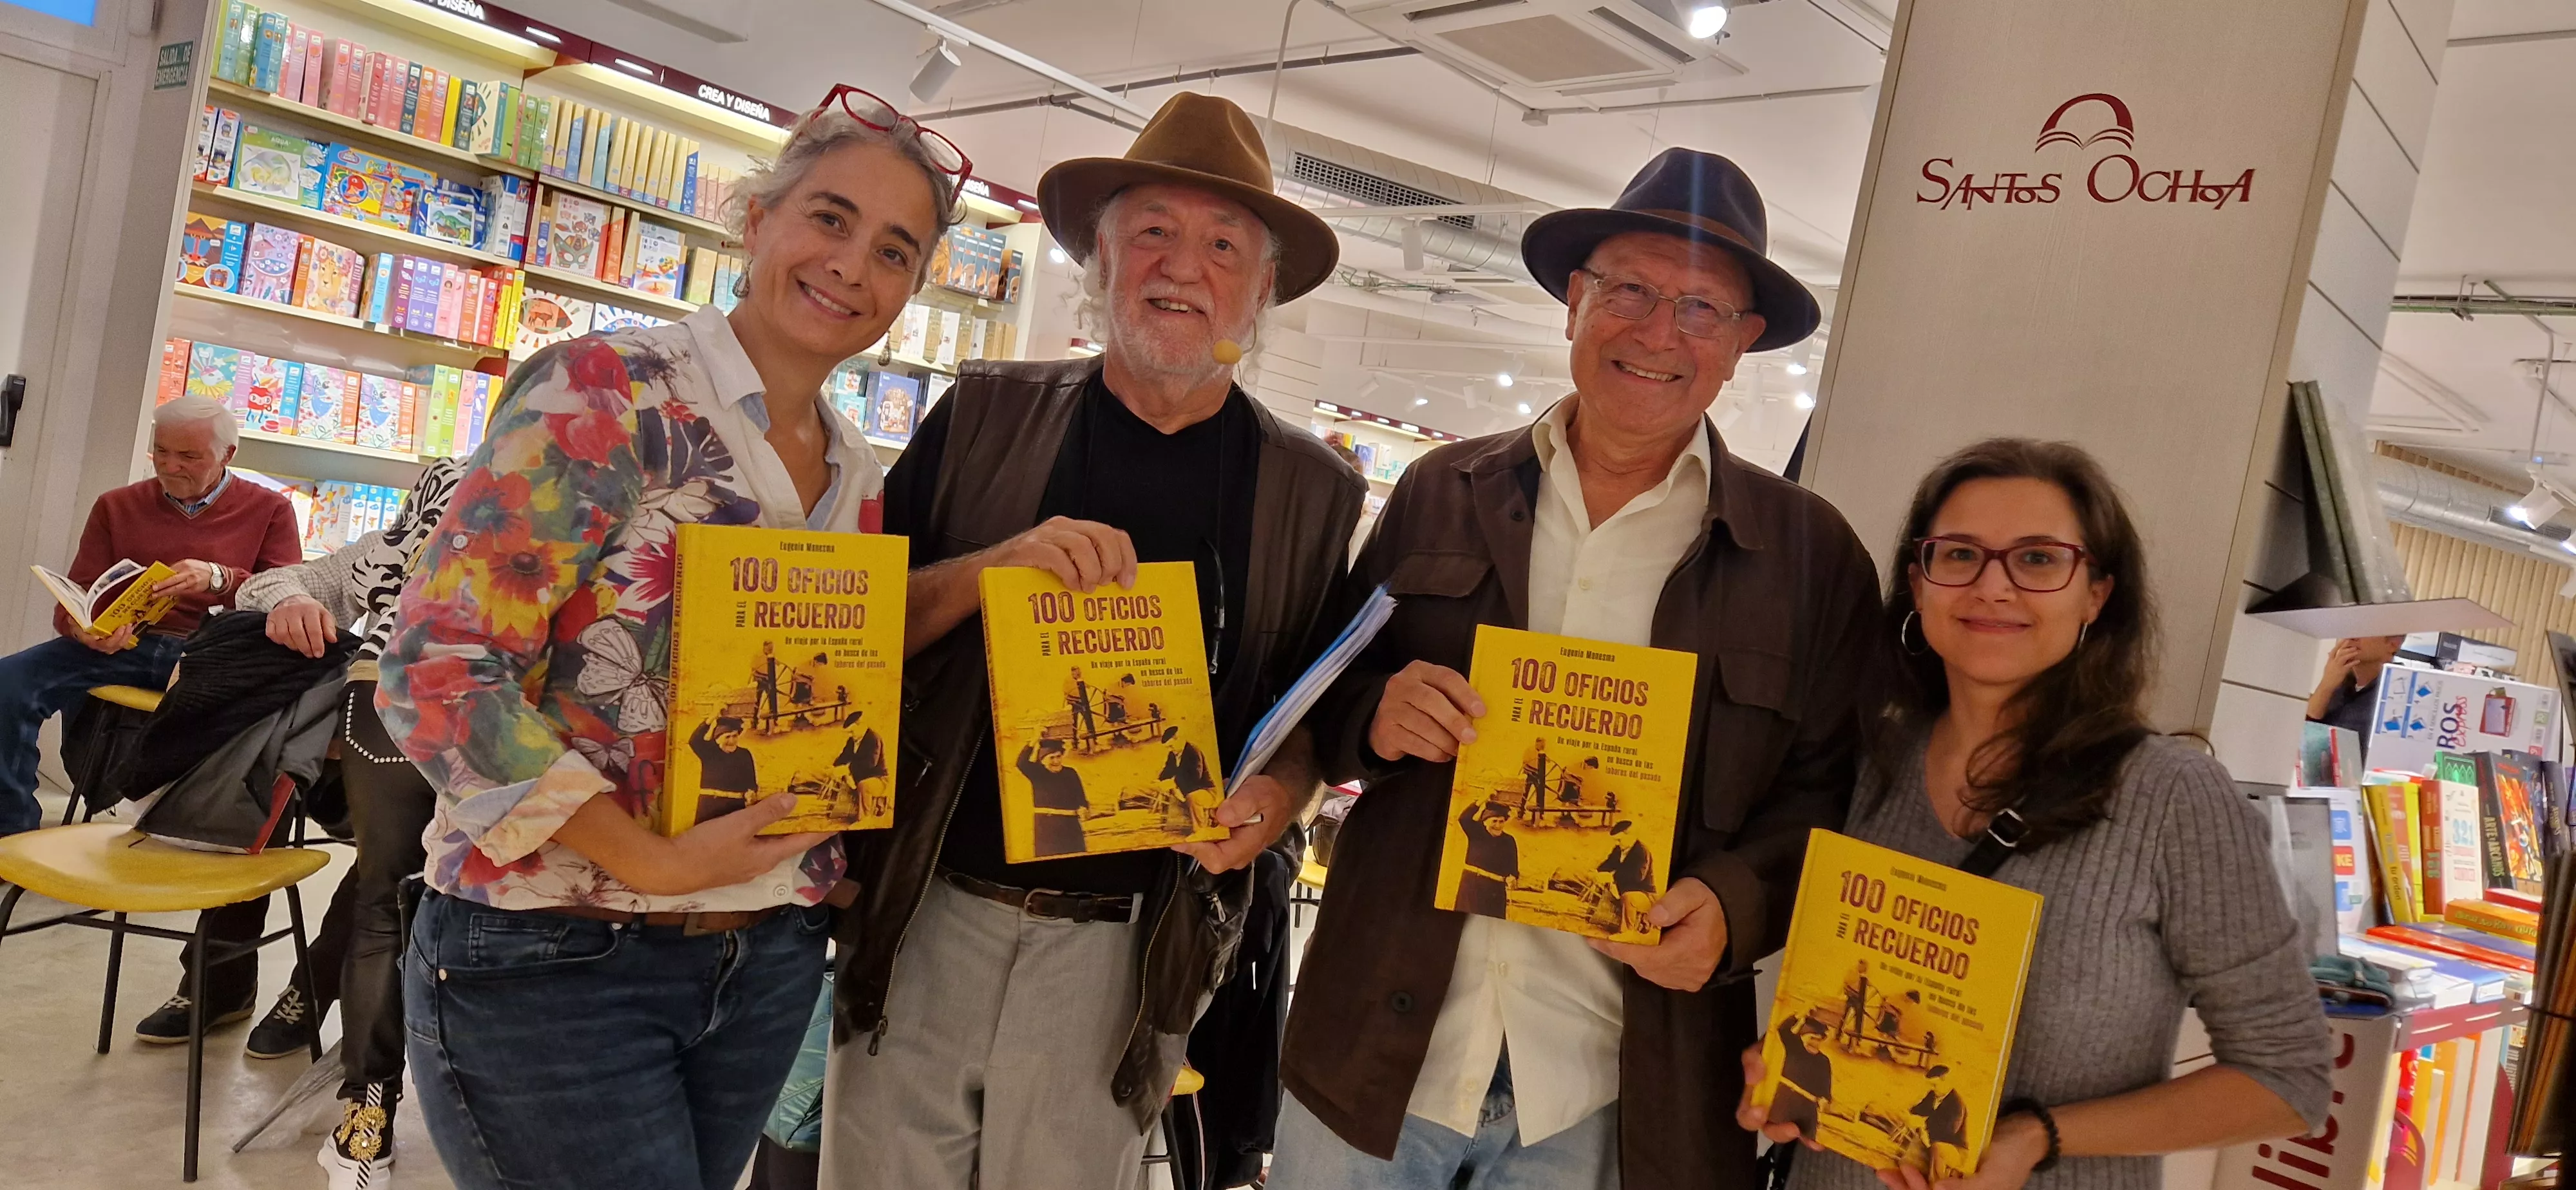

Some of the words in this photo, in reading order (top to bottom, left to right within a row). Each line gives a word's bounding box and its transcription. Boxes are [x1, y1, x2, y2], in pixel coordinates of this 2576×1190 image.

[183, 44, 192, 62] DE
[698, 84, 725, 105] CREA
[726, 93, 735, 108] Y
[734, 97, 770, 122] DISEÑA
[1917, 158, 2062, 211] SANTOS
[2087, 155, 2257, 211] OCHOA
[730, 557, 779, 593] 100
[788, 567, 869, 596] OFICIOS
[735, 607, 746, 628] PARA
[753, 601, 866, 630] RECUERDO
[1028, 591, 1075, 624] 100
[1083, 595, 1162, 622] OFICIOS
[1042, 640, 1052, 657] PARA
[1057, 626, 1165, 656] RECUERDO
[1560, 647, 1584, 660] Eugenio
[1586, 650, 1615, 663] Monesma
[1511, 657, 1557, 694] 100
[1564, 672, 1649, 707] OFICIOS
[1511, 706, 1522, 722] PARA
[1529, 699, 1643, 740] RECUERDO
[1839, 870, 1886, 914] 100
[1891, 894, 1980, 946] OFICIOS
[1853, 917, 1971, 981] RECUERDO
